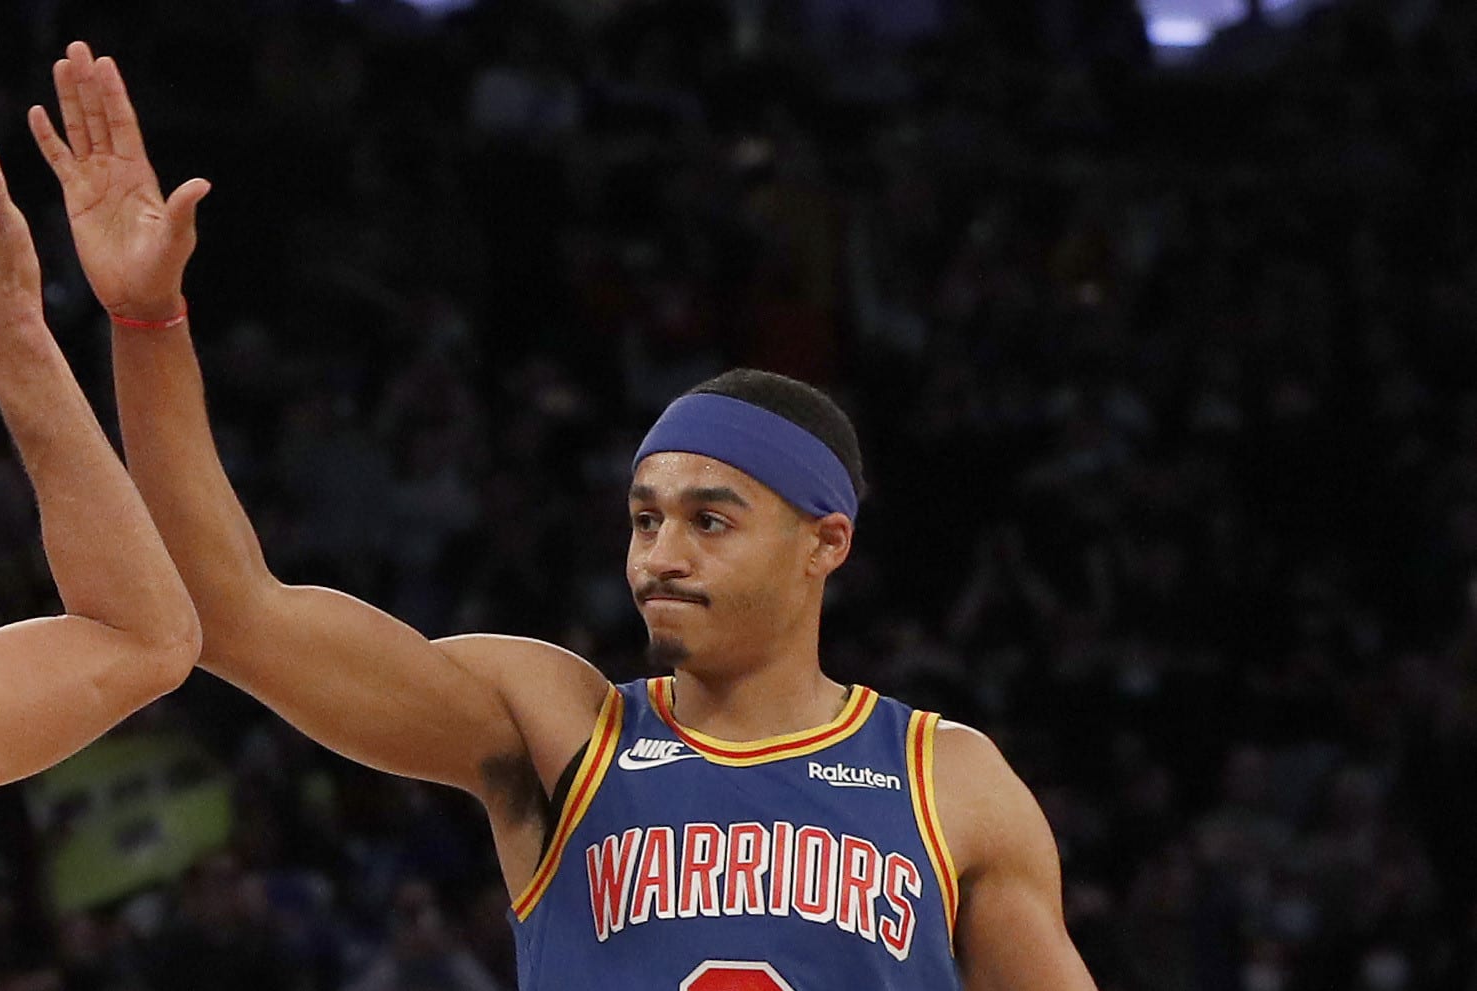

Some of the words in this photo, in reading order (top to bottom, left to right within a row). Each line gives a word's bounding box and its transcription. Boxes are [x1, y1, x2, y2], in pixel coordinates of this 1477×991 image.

[629, 738, 685, 760] NIKE
[808, 761, 901, 791] Rakuten
[586, 820, 923, 962] WARRIORS
